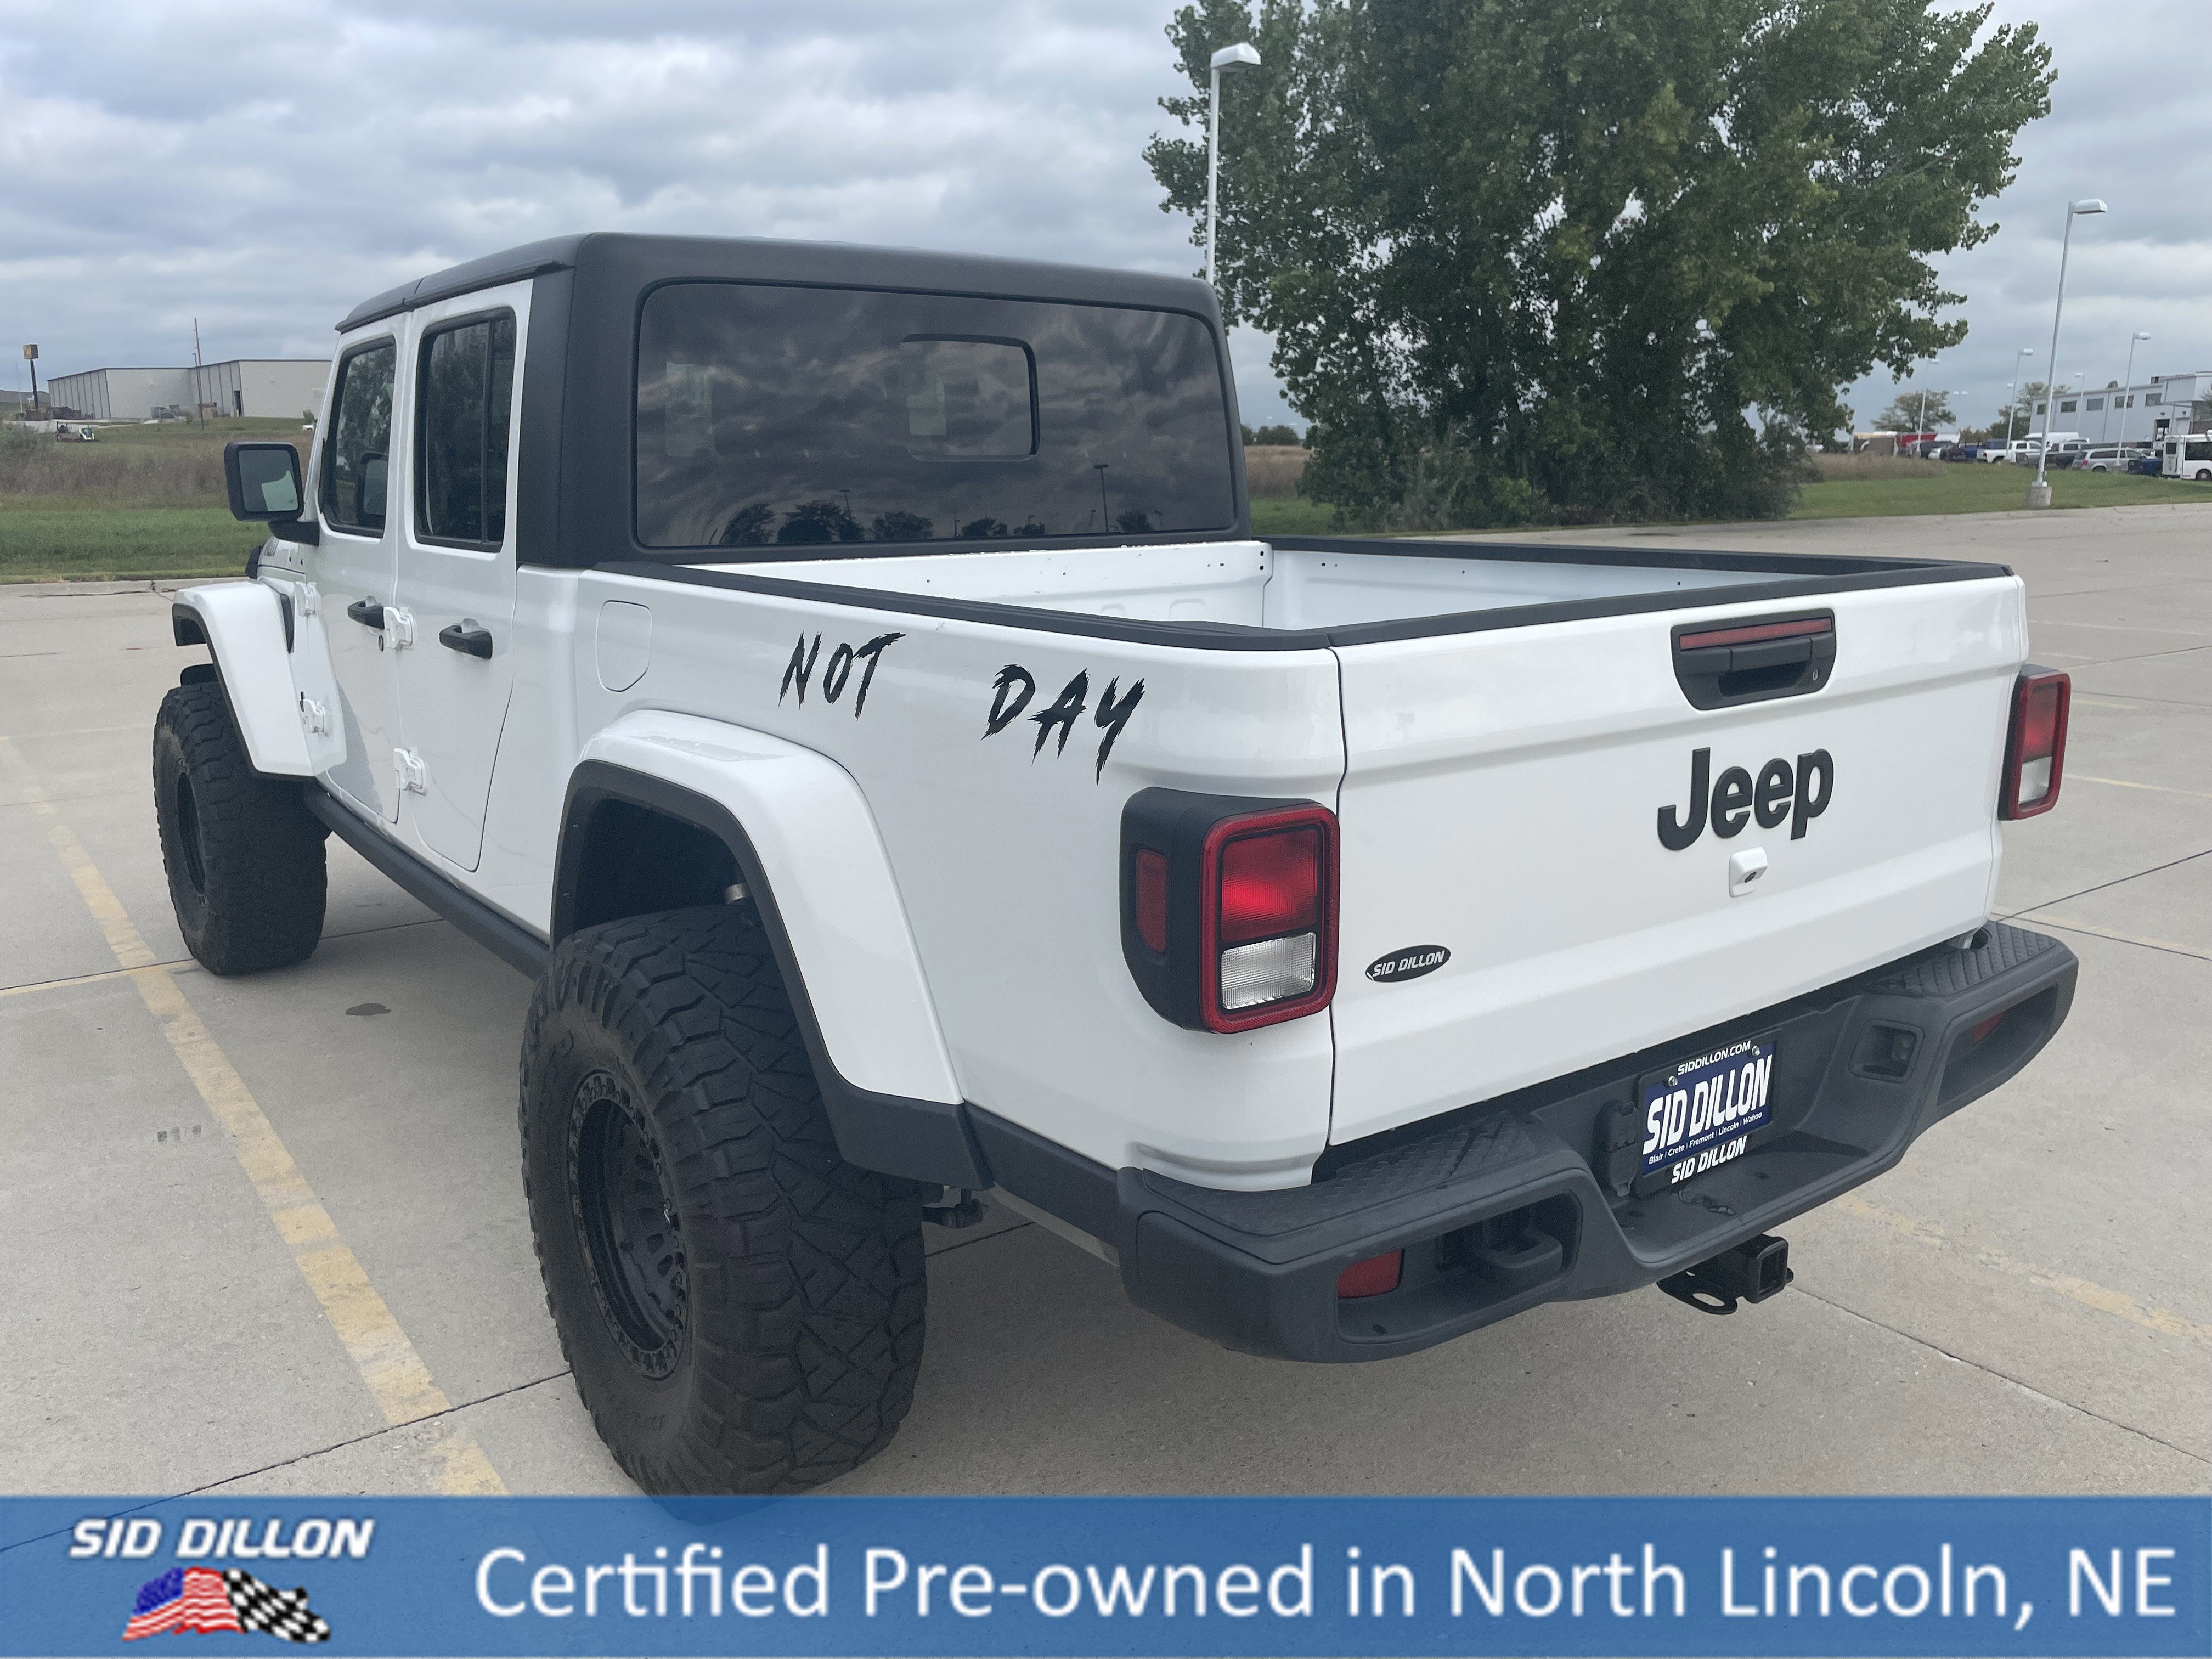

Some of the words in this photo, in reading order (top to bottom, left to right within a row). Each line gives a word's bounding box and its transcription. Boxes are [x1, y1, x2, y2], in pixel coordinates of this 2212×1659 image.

[778, 631, 906, 721] NOT
[980, 664, 1146, 786] DAY
[1657, 747, 1834, 850] Jeep
[1372, 961, 1395, 977] SID
[1397, 950, 1445, 972] DILLON
[1678, 1040, 1751, 1076] SIDDILLON.COM
[1643, 1089, 1688, 1155] SID
[1688, 1054, 1773, 1137] DILLON
[1649, 1153, 1664, 1165] Blair
[1668, 1145, 1685, 1157] Crete
[1689, 1132, 1714, 1148] Fremont
[1718, 1122, 1739, 1136] Lincoln
[1743, 1111, 1763, 1125] Wahoo
[1671, 1157, 1695, 1184] SID
[1697, 1135, 1747, 1173] DILLON
